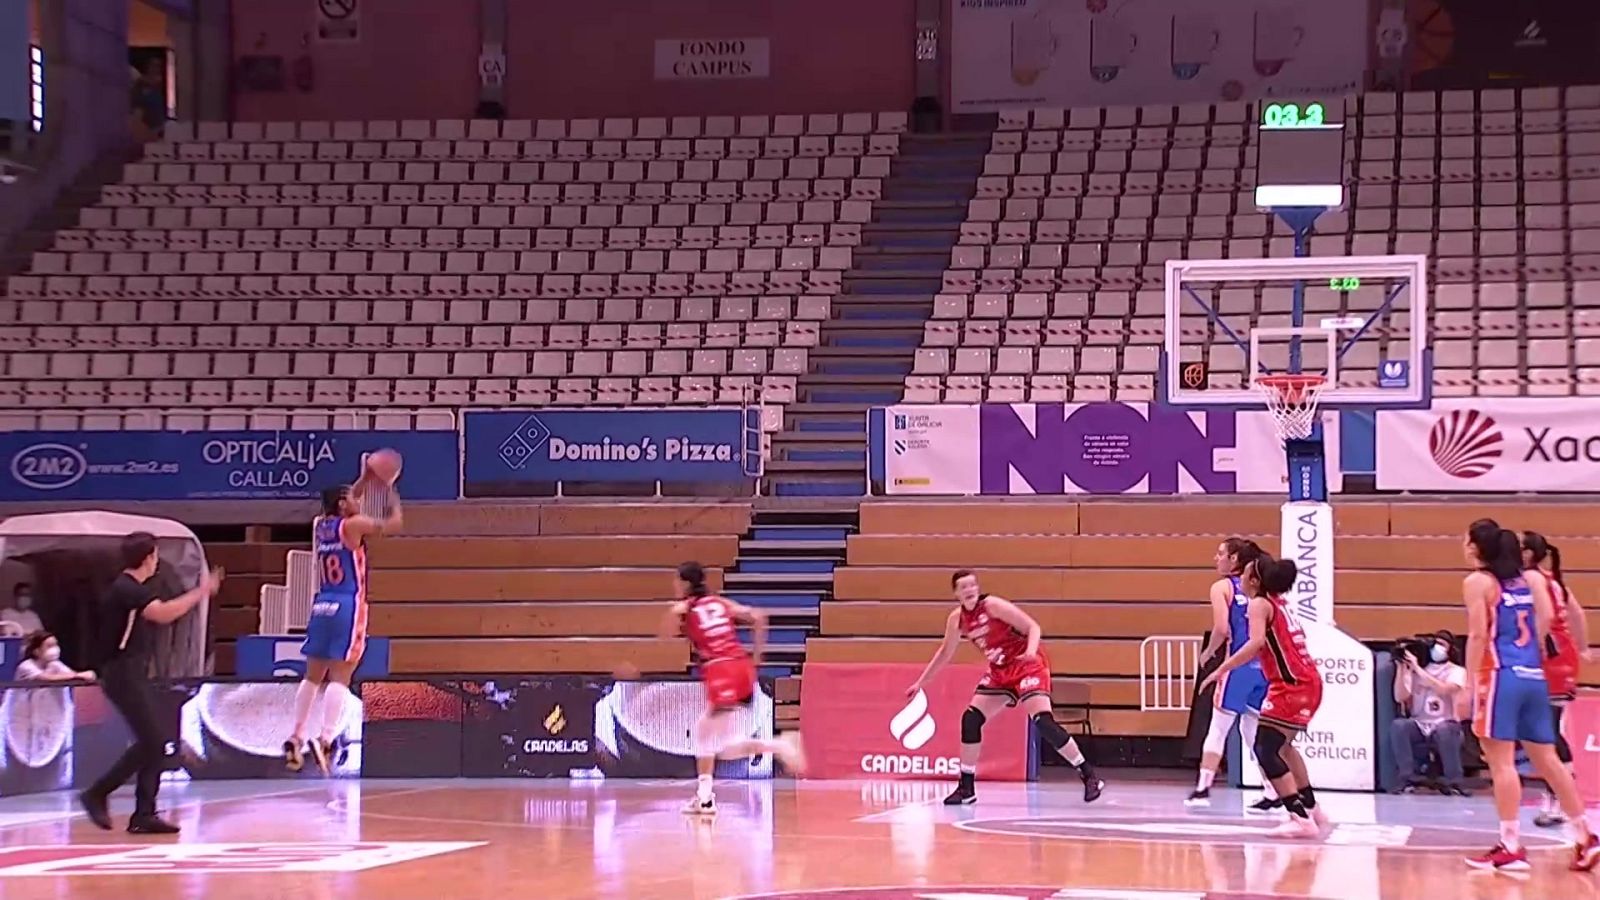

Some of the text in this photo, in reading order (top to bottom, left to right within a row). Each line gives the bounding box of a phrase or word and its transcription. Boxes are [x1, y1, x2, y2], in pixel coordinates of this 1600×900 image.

[680, 41, 745, 56] FONDO
[673, 61, 752, 76] CAMPUS
[1264, 103, 1324, 125] 03.3
[549, 437, 731, 461] Domino's Pizza
[22, 457, 75, 476] 2M2
[229, 470, 309, 487] CALLAO
[1315, 658, 1366, 670] PORTE
[1325, 673, 1359, 684] EGO
[1295, 731, 1334, 743] UNTA
[1305, 746, 1367, 760] GALICIA
[861, 754, 961, 775] CANDELAS
